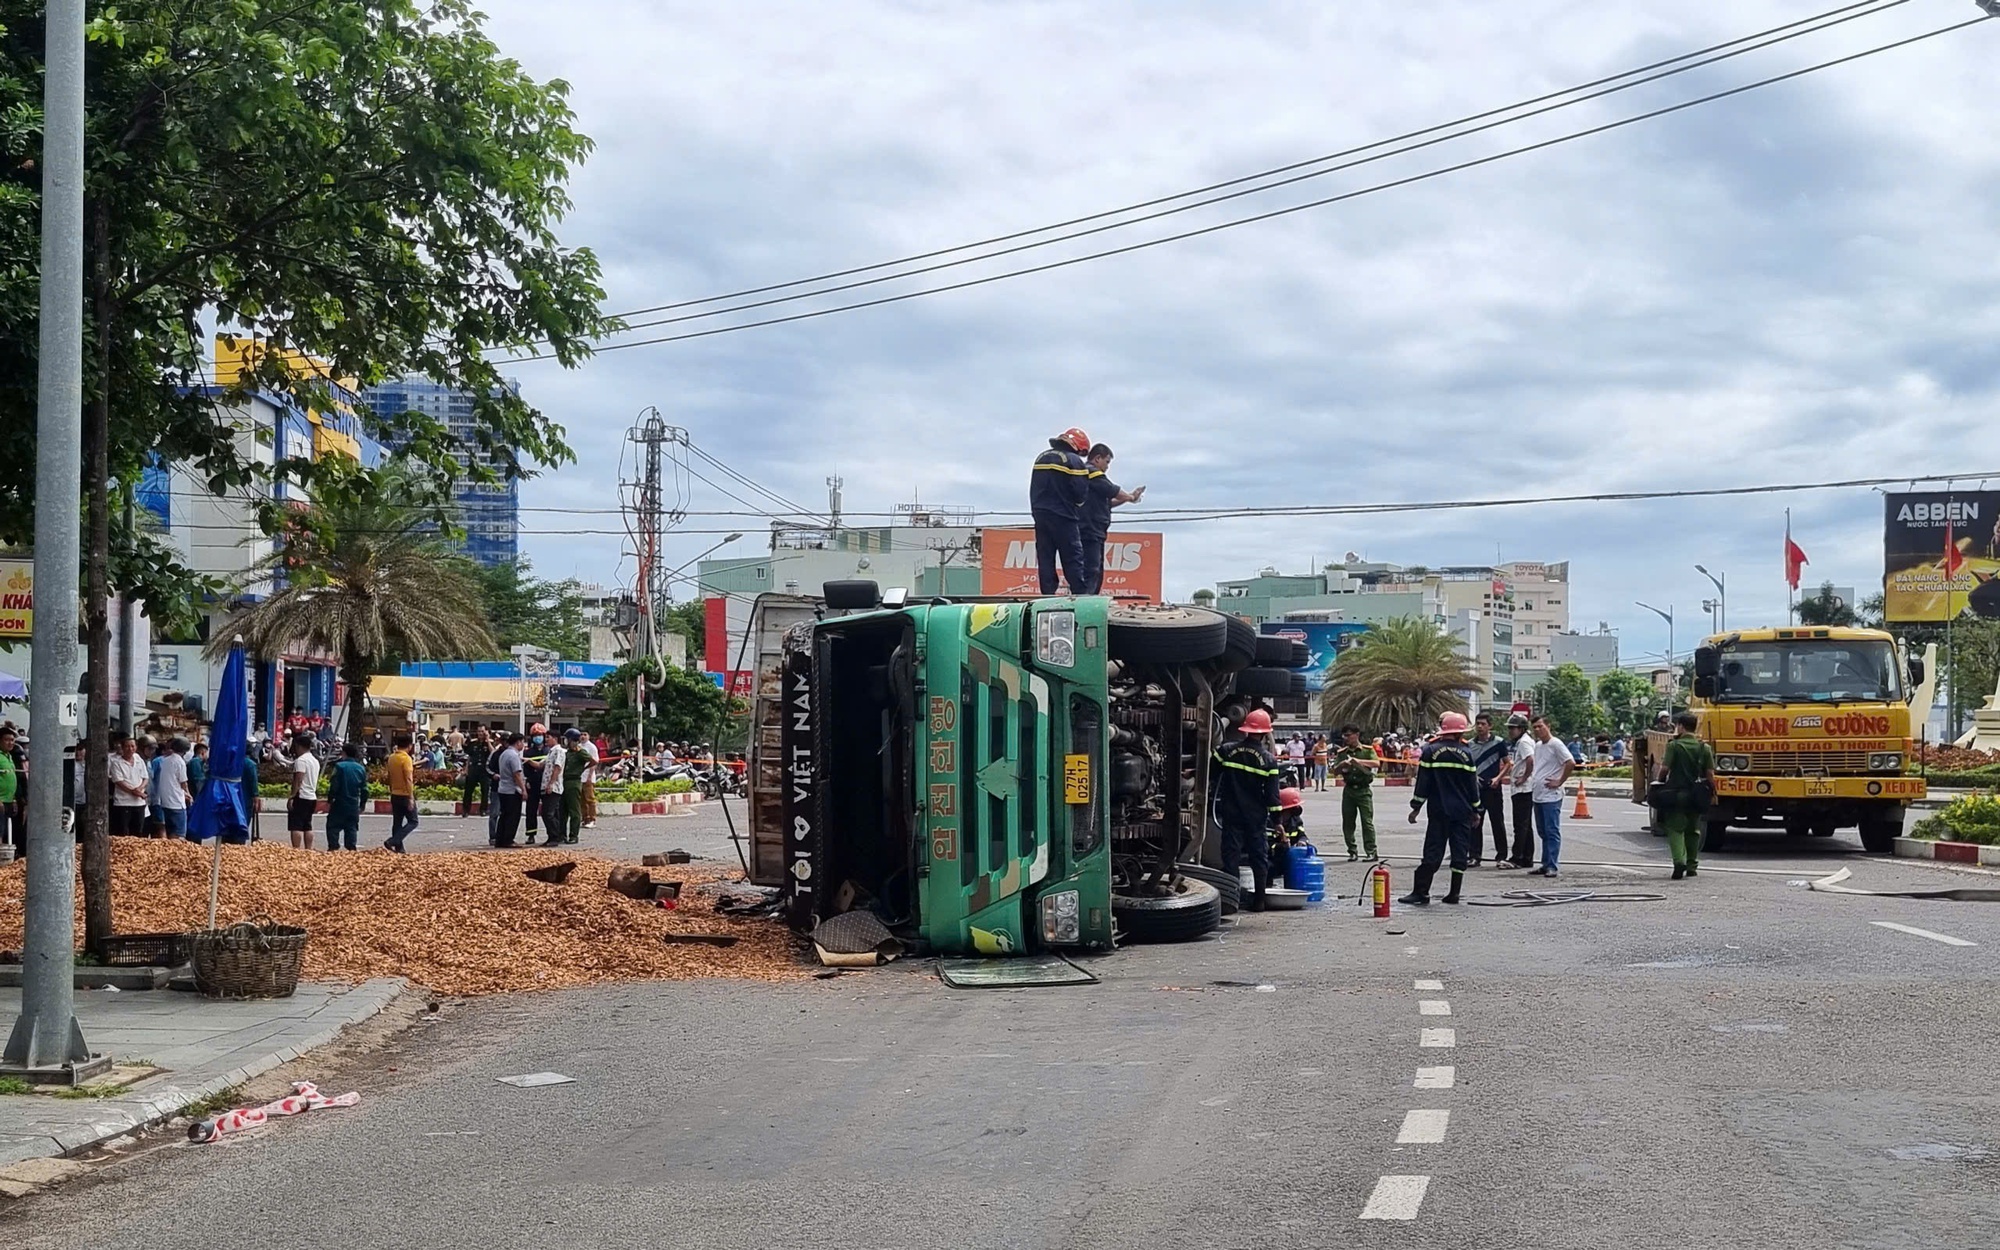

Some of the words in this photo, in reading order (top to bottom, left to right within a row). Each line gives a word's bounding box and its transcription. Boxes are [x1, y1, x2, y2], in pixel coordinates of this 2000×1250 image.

[1897, 503, 1979, 521] ABBEN
[1734, 717, 1789, 736] DANH
[1797, 742, 1833, 751] GIAO
[1066, 768, 1076, 790] 77H
[1077, 760, 1088, 798] 025.17
[1910, 781, 1924, 793] XE
